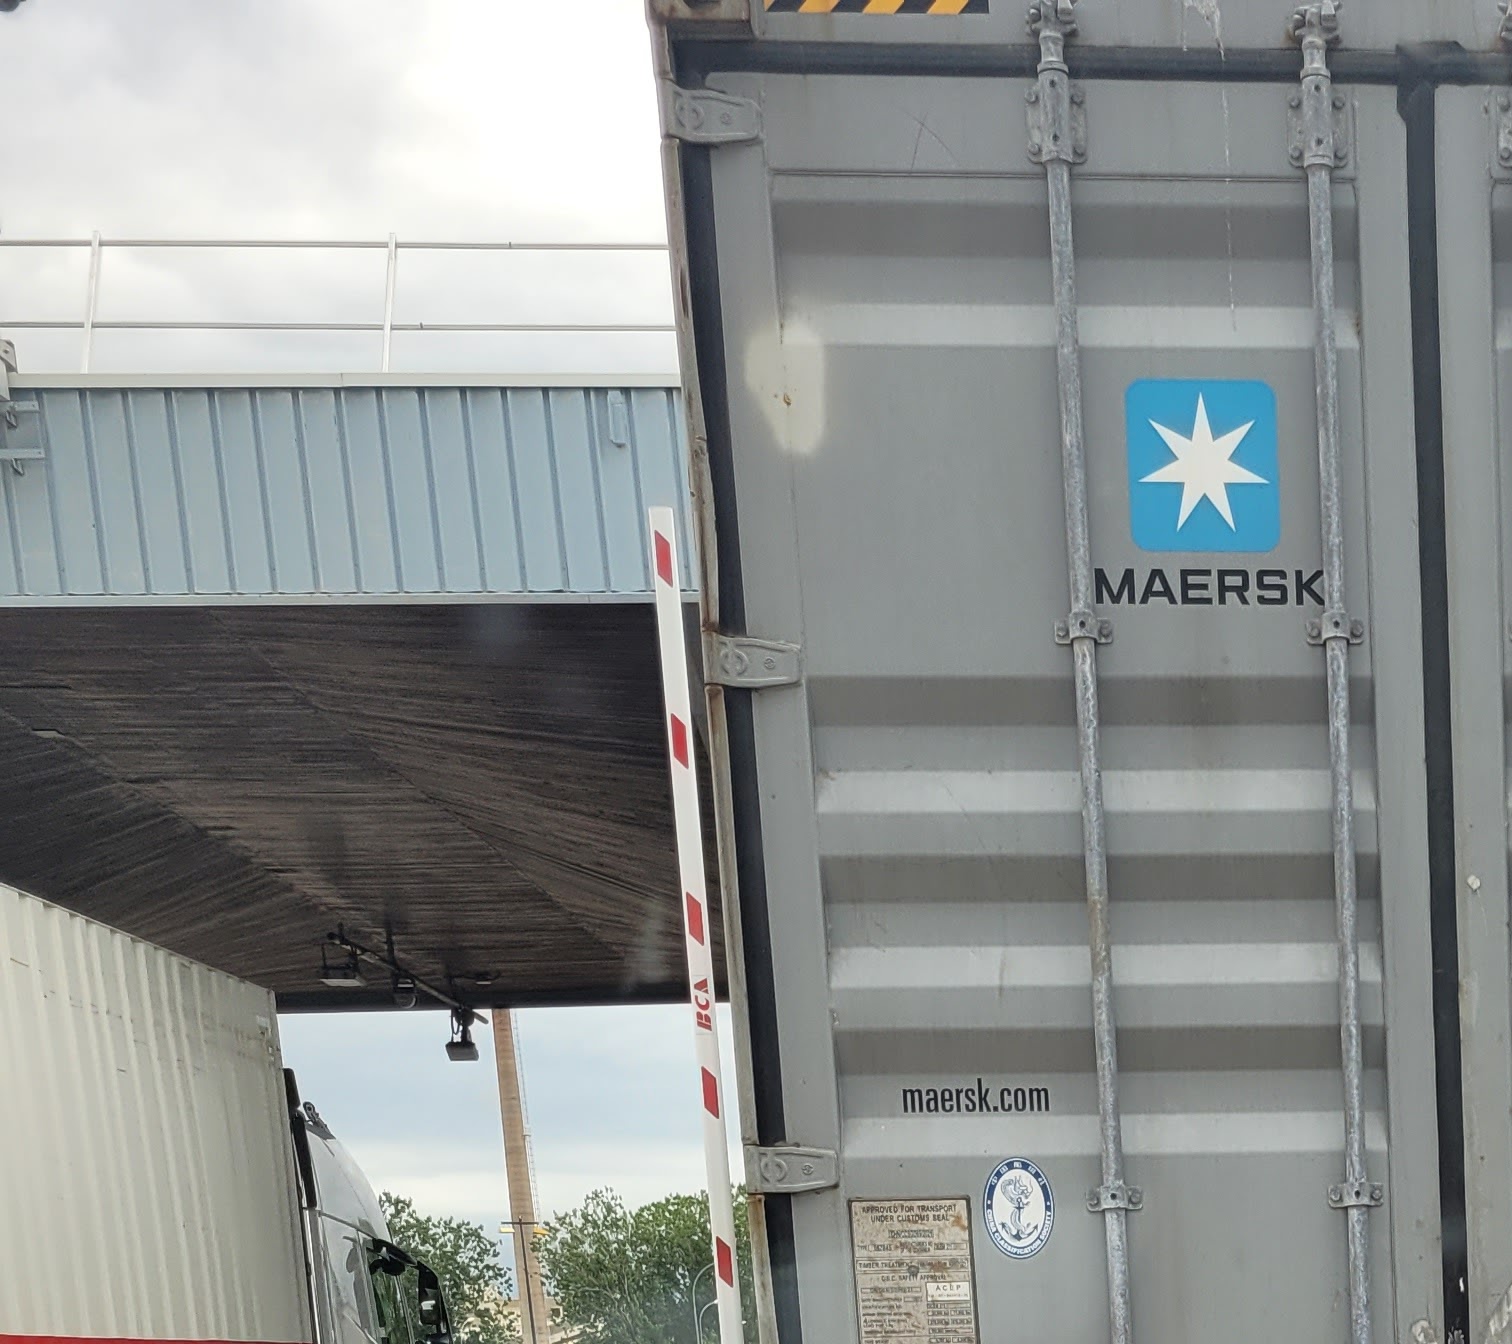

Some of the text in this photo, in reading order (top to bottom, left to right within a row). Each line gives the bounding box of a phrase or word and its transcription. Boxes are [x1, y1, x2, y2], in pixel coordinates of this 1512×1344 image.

[1093, 567, 1325, 606] MAERSK
[902, 1077, 1050, 1114] maersk.com
[861, 1204, 957, 1214] APPROVED FOR TRANSPORT
[870, 1213, 950, 1223] UNDER CUSTOMS SEAL
